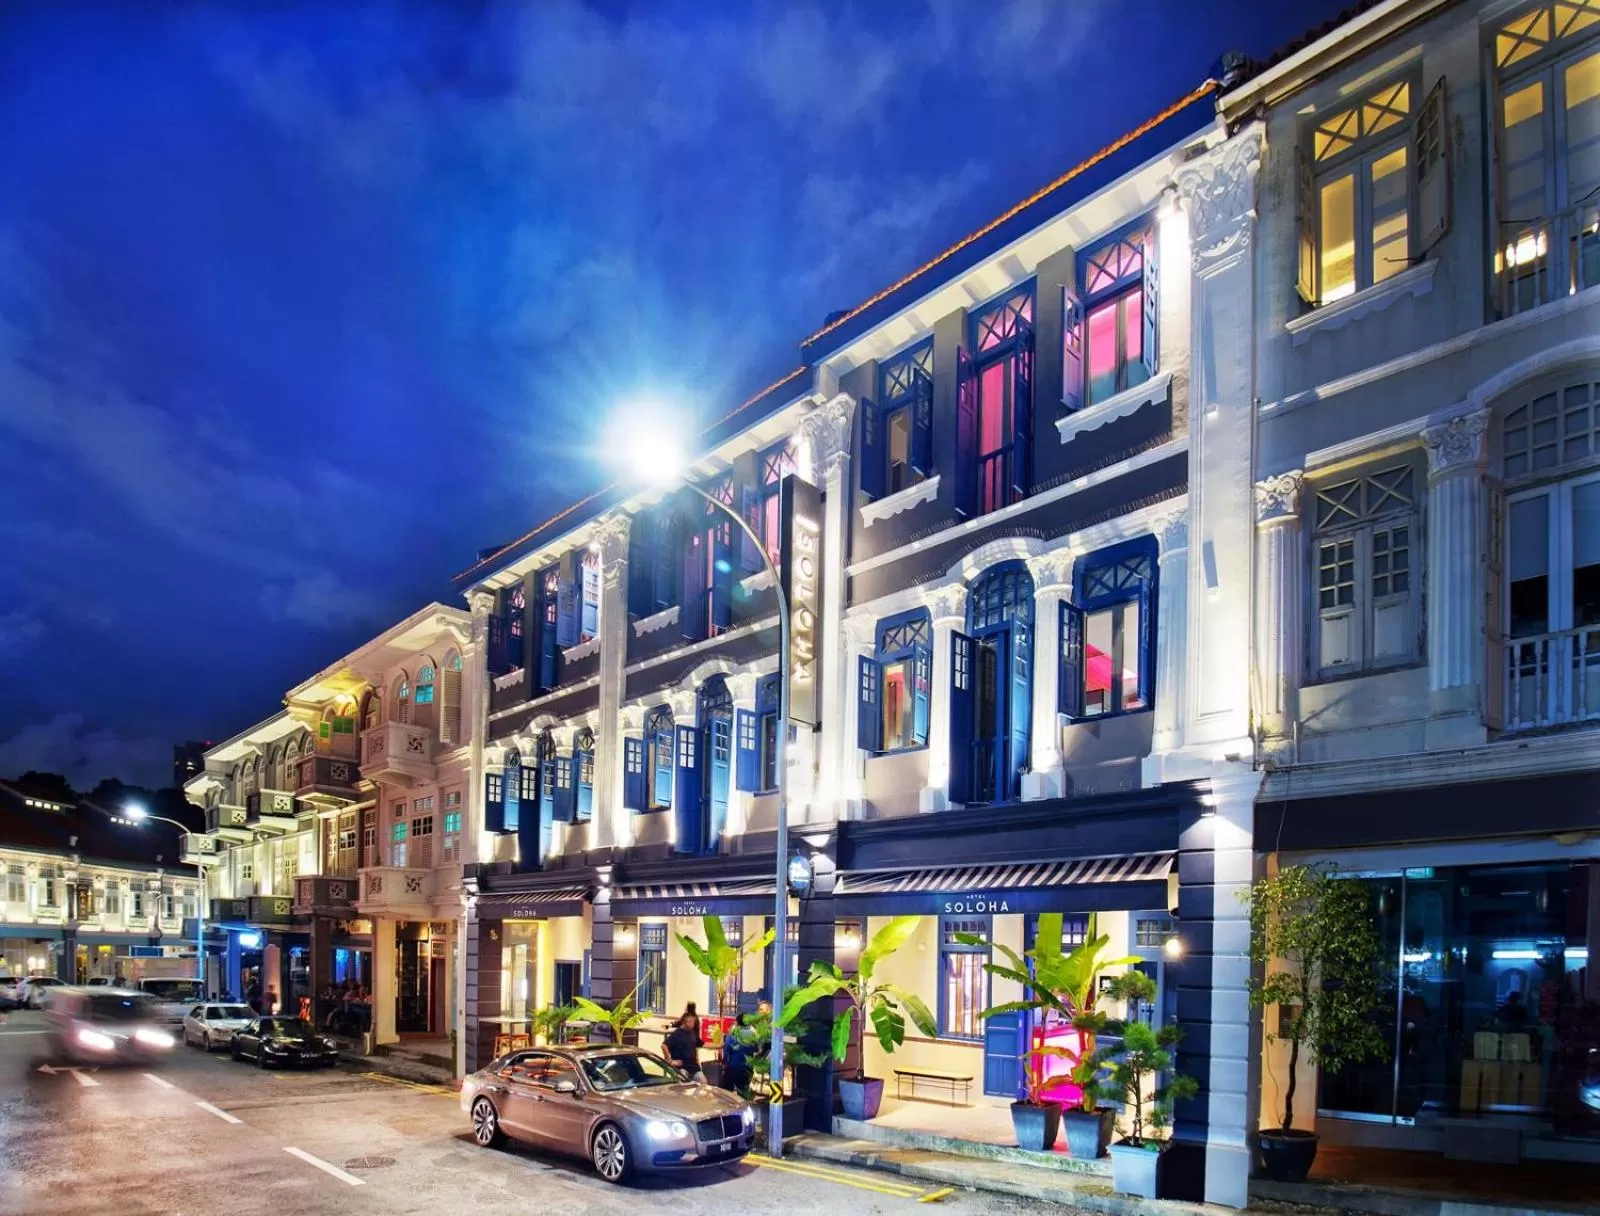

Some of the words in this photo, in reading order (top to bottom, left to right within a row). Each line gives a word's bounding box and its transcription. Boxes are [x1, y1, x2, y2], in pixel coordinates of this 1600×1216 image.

[796, 526, 816, 682] SOLOHA
[671, 905, 707, 916] SOLOHA
[944, 901, 1009, 913] SOLOHA
